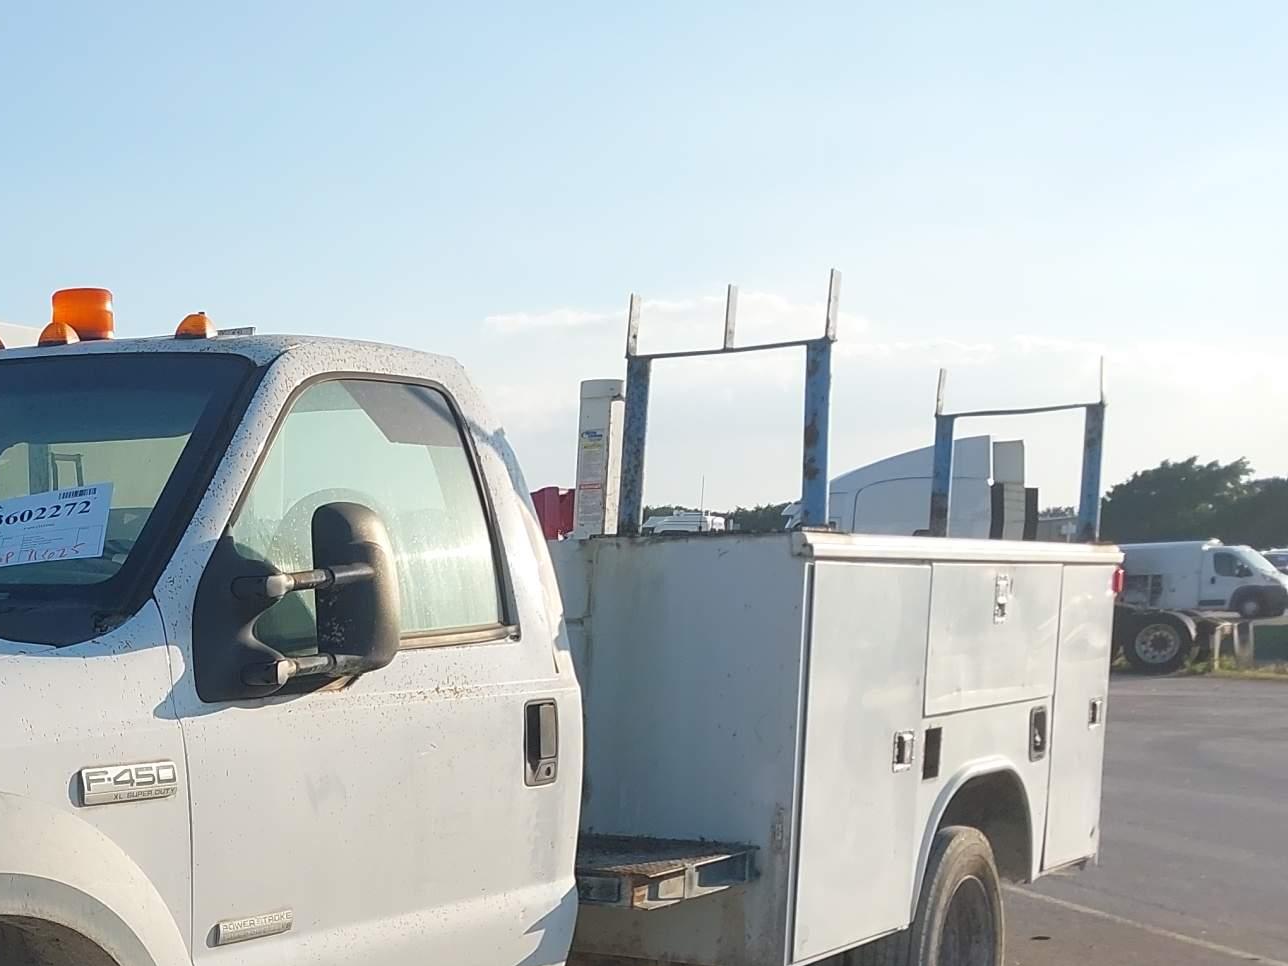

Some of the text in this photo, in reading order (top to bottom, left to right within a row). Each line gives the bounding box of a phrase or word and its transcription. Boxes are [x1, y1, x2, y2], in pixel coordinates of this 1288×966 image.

[84, 764, 177, 792] F-450
[126, 789, 153, 799] SUPER
[154, 786, 178, 797] DUTY
[222, 919, 256, 932] POWER
